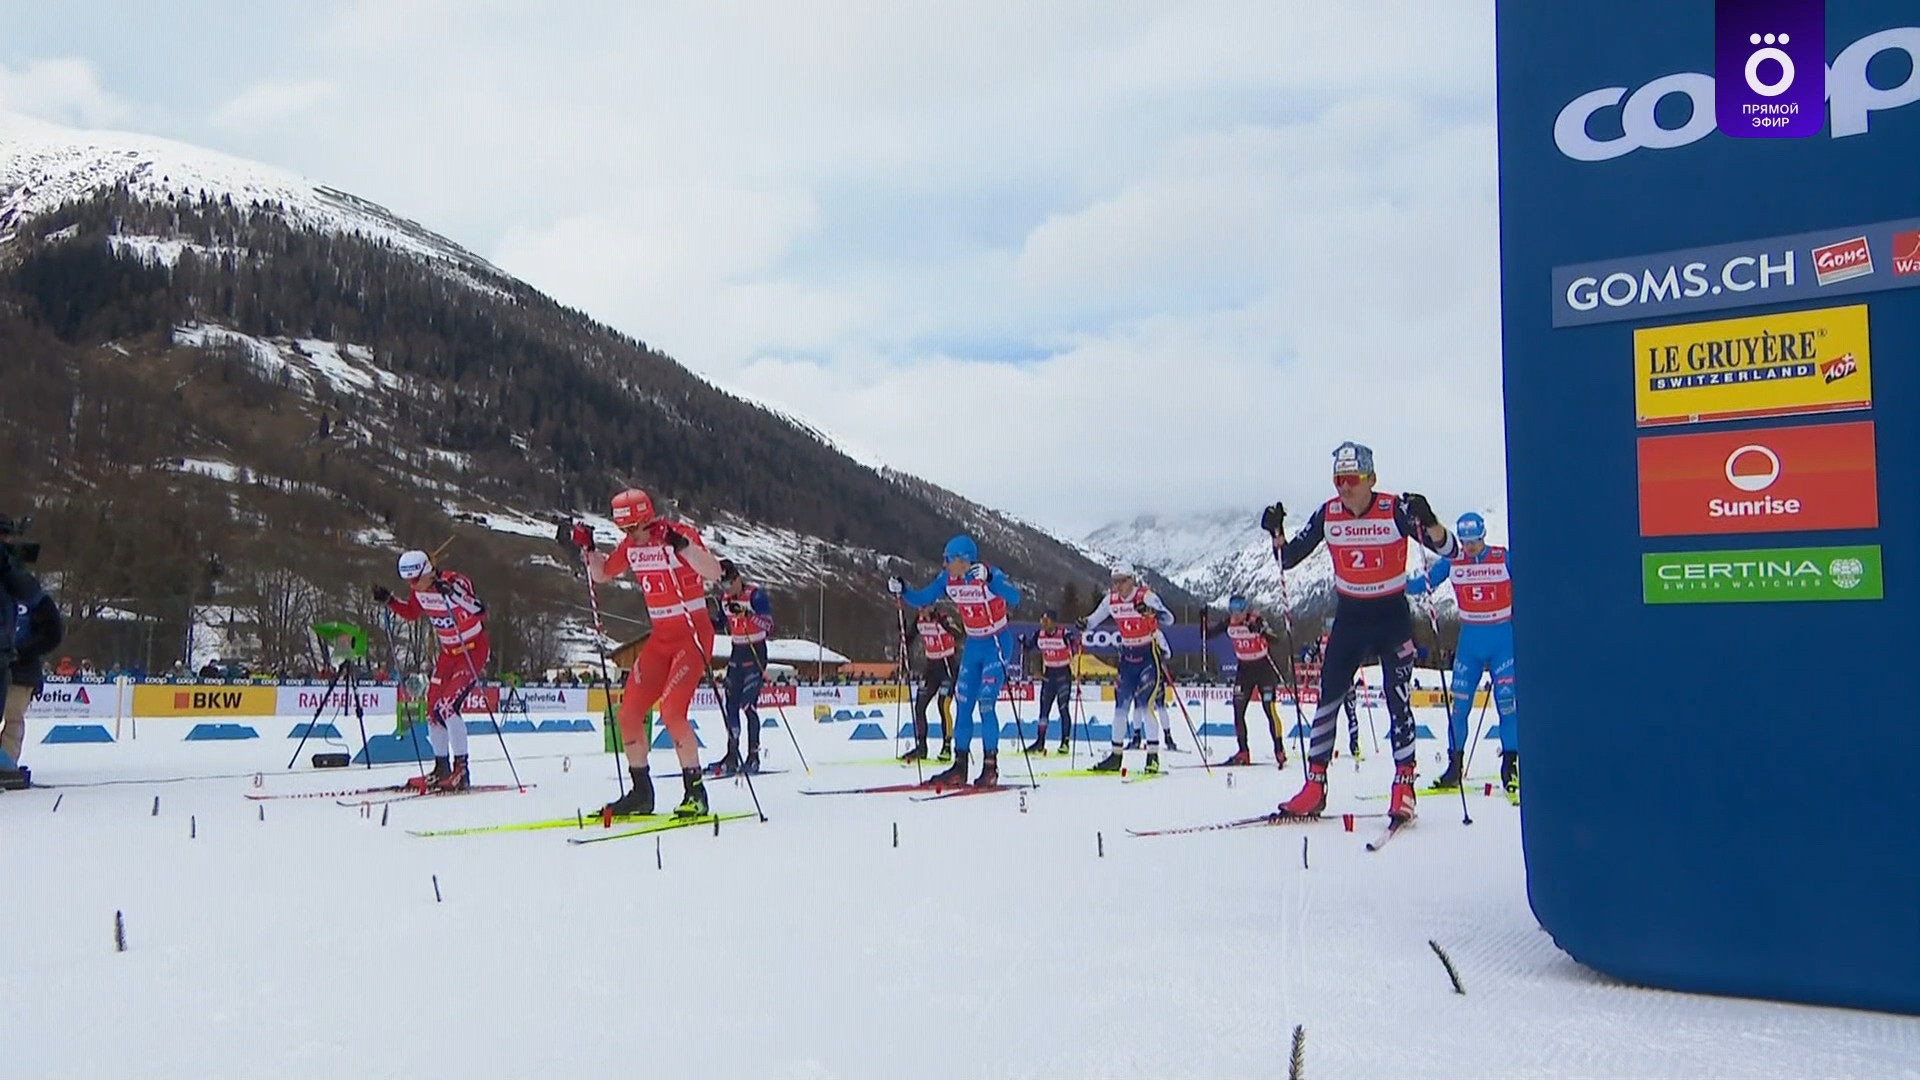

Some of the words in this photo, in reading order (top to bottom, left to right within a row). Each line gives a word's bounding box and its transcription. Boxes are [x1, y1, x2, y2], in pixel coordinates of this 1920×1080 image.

[1554, 26, 1920, 162] cop
[1566, 250, 1795, 312] GOMS.CH
[1648, 345, 1680, 374] LE
[1656, 365, 1808, 390] SWITZERLAND
[1708, 495, 1801, 517] Sunrise
[1344, 525, 1391, 537] Sunrise
[1350, 551, 1365, 569] 2
[1466, 567, 1503, 578] Sunrise
[1658, 560, 1822, 580] CERTINA
[642, 576, 652, 593] 6
[1733, 579, 1822, 588] WATCHES
[1472, 587, 1483, 601] 5
[965, 606, 974, 618] 3
[193, 692, 243, 709] BKW
